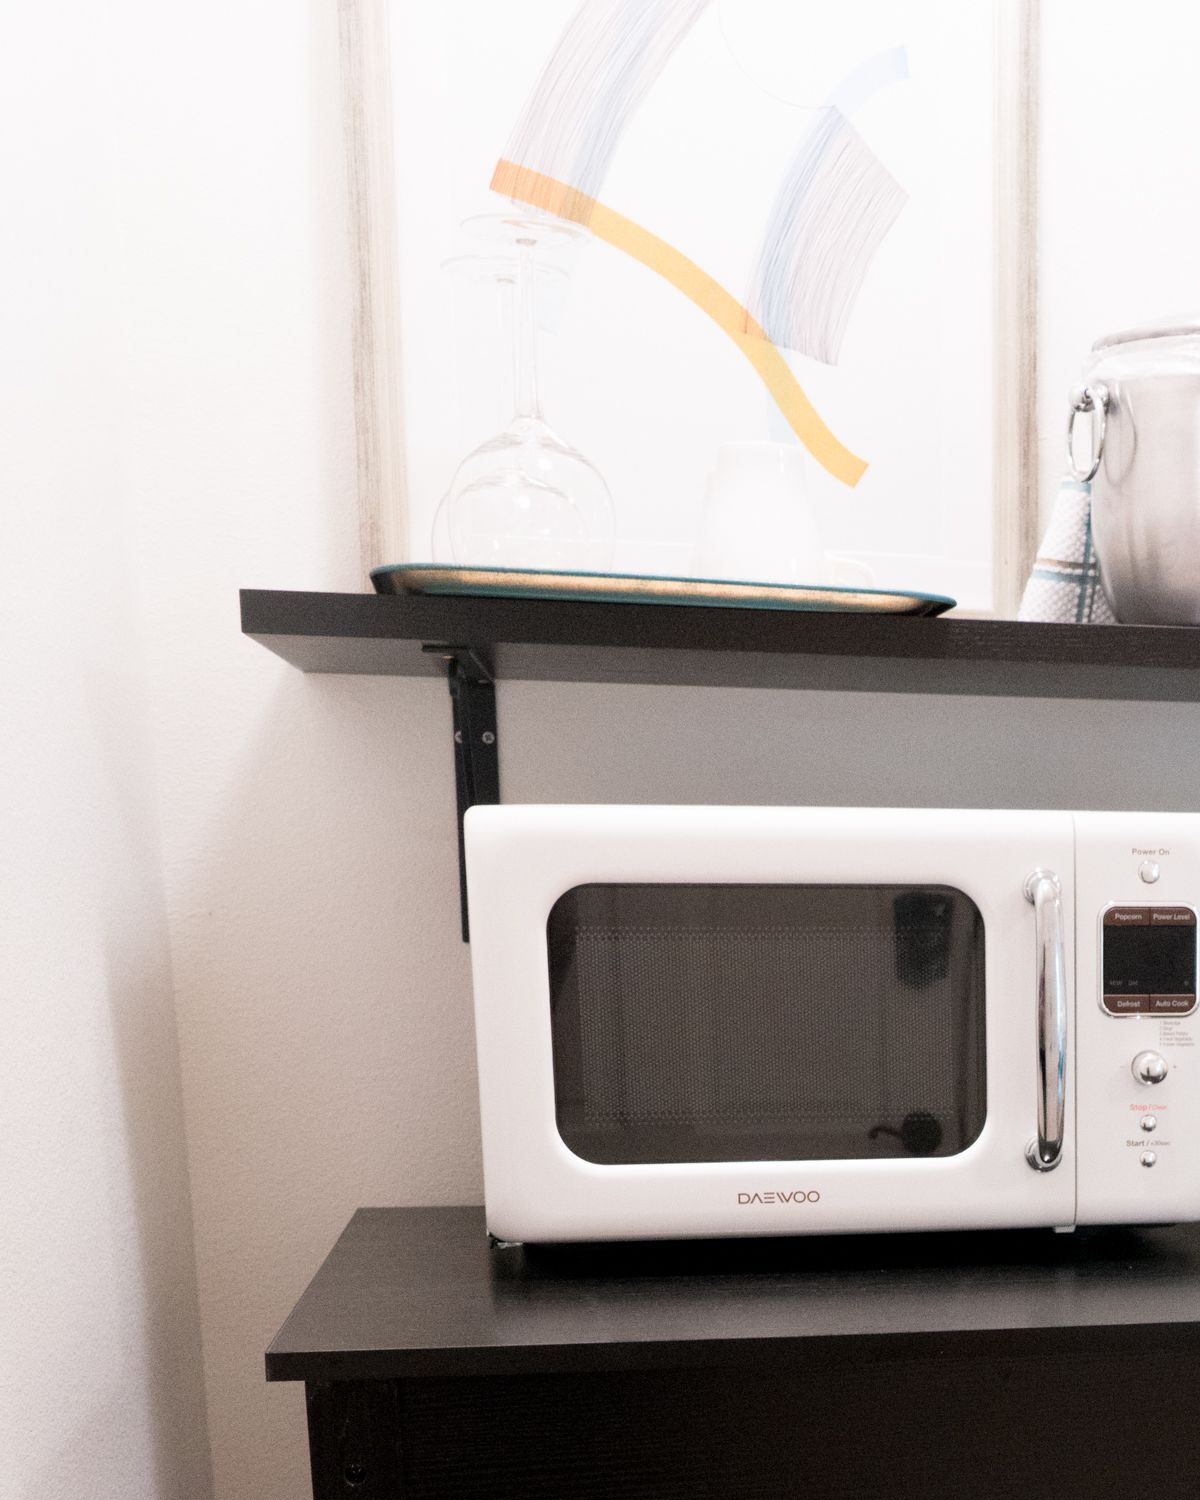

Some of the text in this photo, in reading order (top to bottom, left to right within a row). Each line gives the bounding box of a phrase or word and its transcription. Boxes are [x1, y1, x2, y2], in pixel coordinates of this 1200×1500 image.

[1131, 847, 1170, 856] Power On
[1114, 912, 1143, 920] Popcorn
[1117, 1000, 1141, 1008] Defrost
[1155, 999, 1171, 1007] Auto
[1129, 1103, 1147, 1111] Stop
[1126, 1139, 1145, 1147] Start
[738, 1190, 820, 1204] DAEWOO
